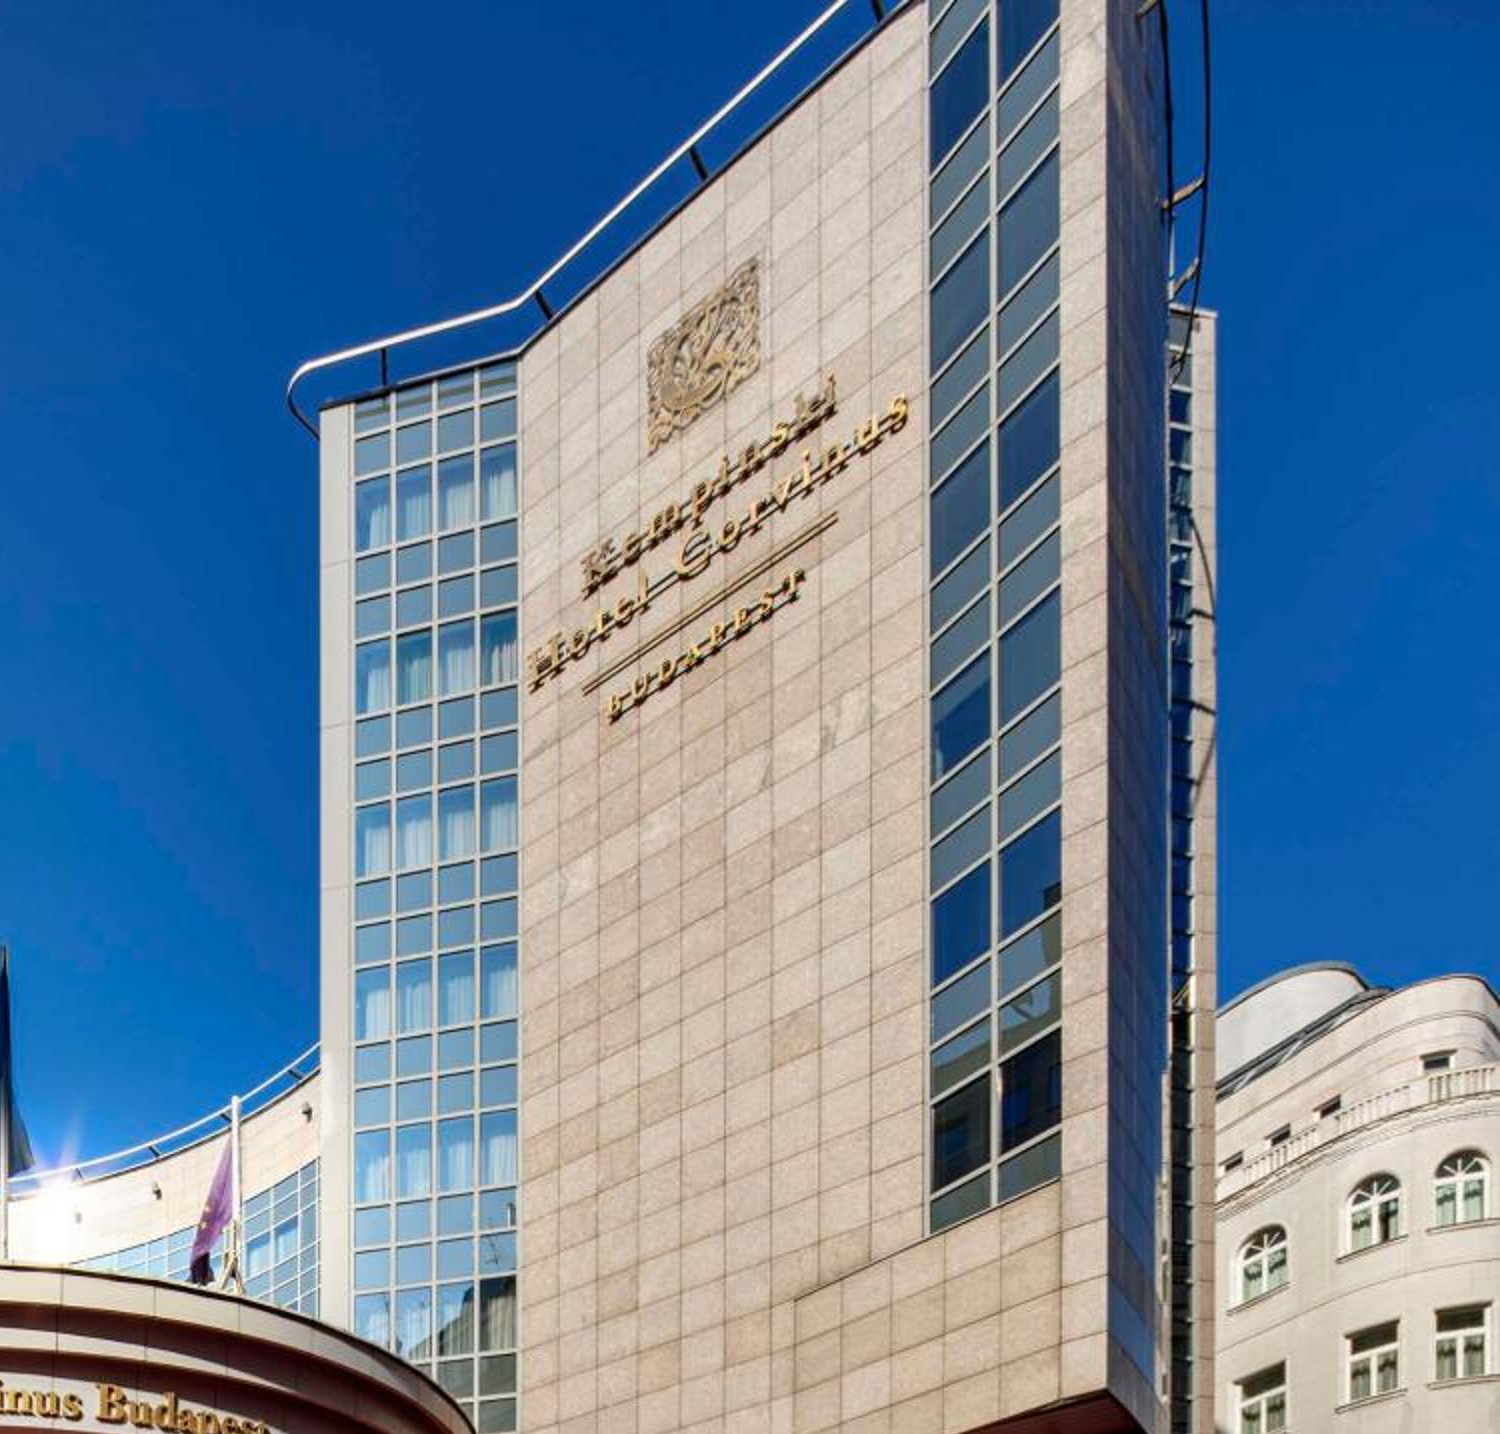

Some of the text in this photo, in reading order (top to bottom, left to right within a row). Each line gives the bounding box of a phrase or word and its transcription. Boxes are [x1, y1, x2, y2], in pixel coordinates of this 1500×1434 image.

[525, 393, 911, 691] Hotel Corvinus
[581, 370, 838, 598] Kempinski
[605, 567, 807, 722] BUDAPEST
